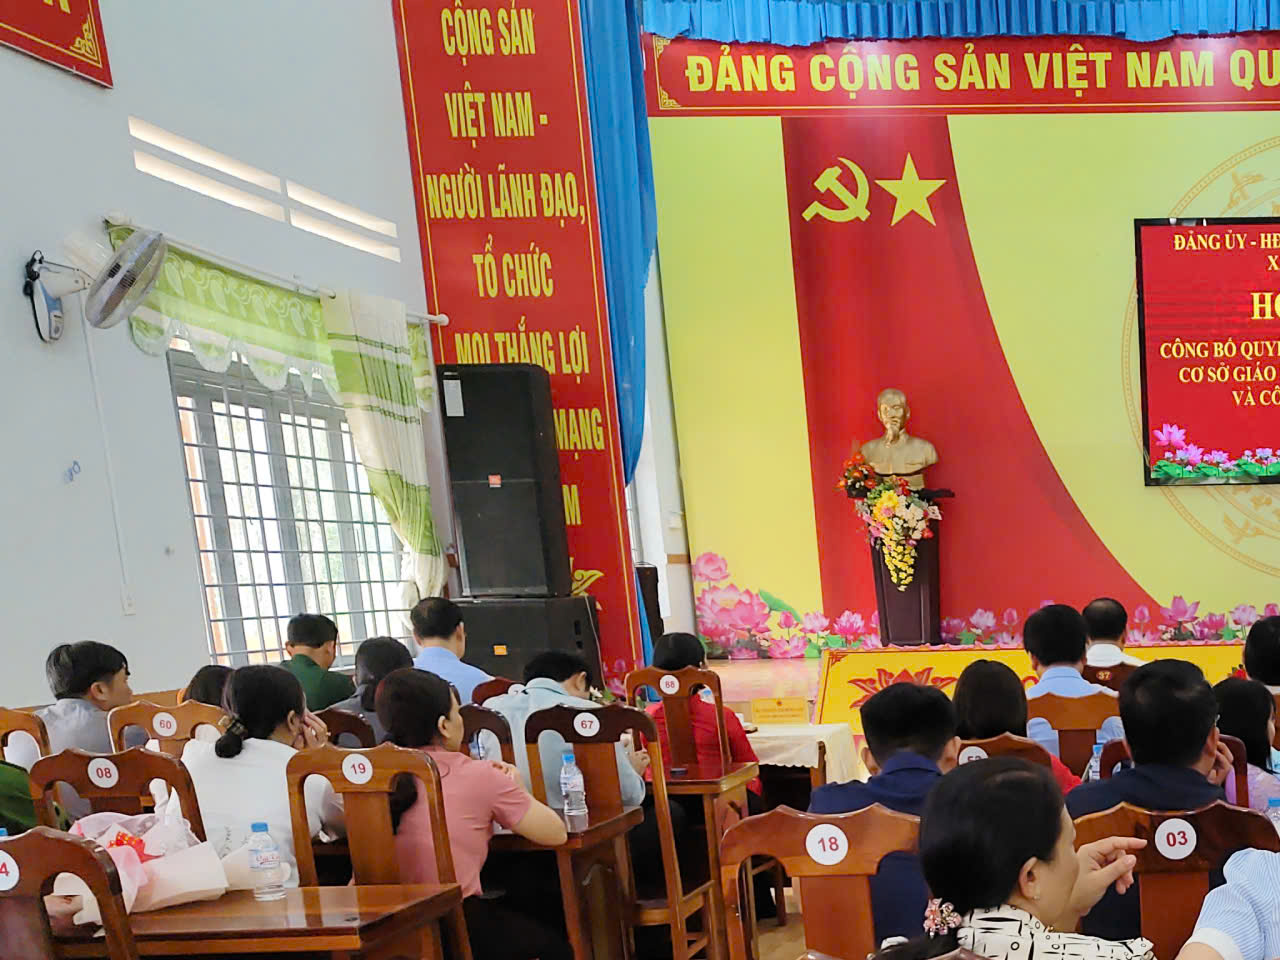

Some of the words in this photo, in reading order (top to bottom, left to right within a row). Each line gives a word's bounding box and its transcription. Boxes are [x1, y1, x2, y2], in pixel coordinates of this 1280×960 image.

[441, 0, 495, 66] CỘNG
[686, 44, 797, 93] ĐẢNG
[810, 45, 920, 99] CỘNG
[934, 42, 1013, 91] SẢN
[1024, 43, 1112, 98] VIỆT
[1126, 51, 1215, 88] NAM
[444, 81, 486, 148] VIỆT
[490, 91, 535, 137] NAM
[426, 163, 485, 219] NGƯỜI
[488, 163, 537, 218] LÃNH
[540, 172, 585, 228] ĐẠO,
[1174, 230, 1221, 251] ĐẢNG
[1225, 229, 1247, 249] ỦY
[472, 233, 498, 298] TỔ
[502, 242, 554, 298] CHỨC
[494, 316, 555, 374] THẮNG
[558, 325, 589, 384] LỢI
[1160, 338, 1209, 359] CÔNG
[1213, 337, 1237, 358] BỐ
[1178, 366, 1205, 383] CƠ
[1207, 362, 1229, 383] SỞ
[1232, 361, 1277, 382] GIÁO
[1232, 387, 1256, 406] VÀ
[553, 408, 605, 460] MẠNG
[159, 719, 172, 730] 60
[580, 719, 594, 730] 67
[95, 767, 113, 779] 08
[350, 762, 366, 775] 19
[817, 836, 839, 852] 18
[1166, 830, 1188, 848] 03
[0, 861, 10, 877] 4
